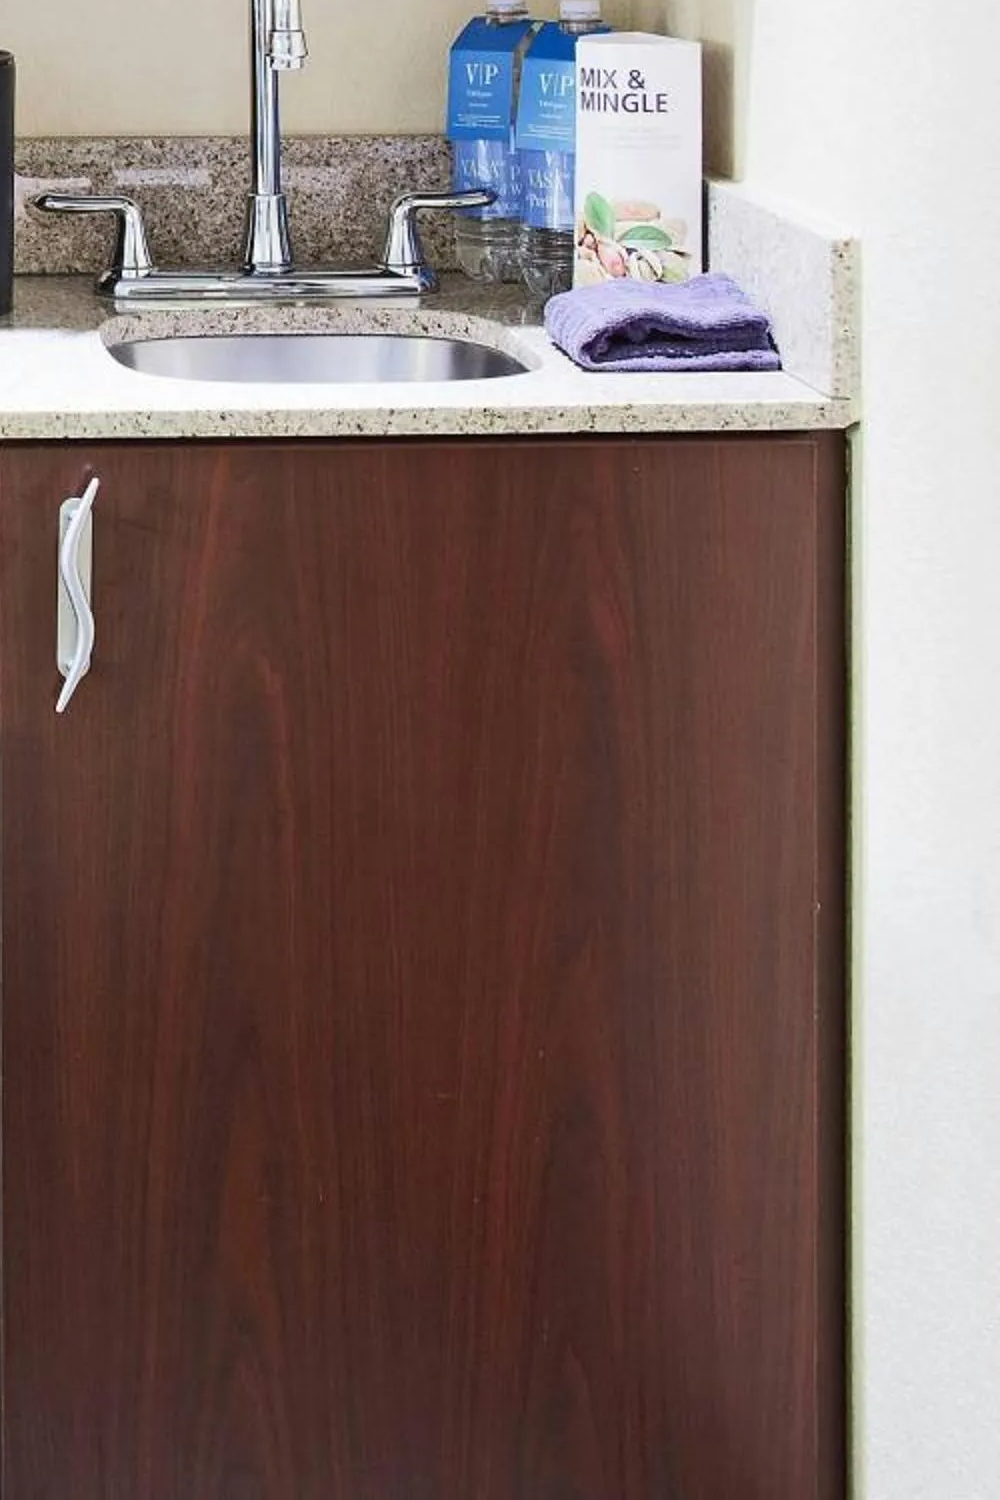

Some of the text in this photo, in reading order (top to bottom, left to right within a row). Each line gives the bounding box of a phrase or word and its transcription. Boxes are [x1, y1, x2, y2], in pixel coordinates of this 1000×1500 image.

[580, 67, 645, 90] MIX &
[580, 91, 669, 113] MINGLE
